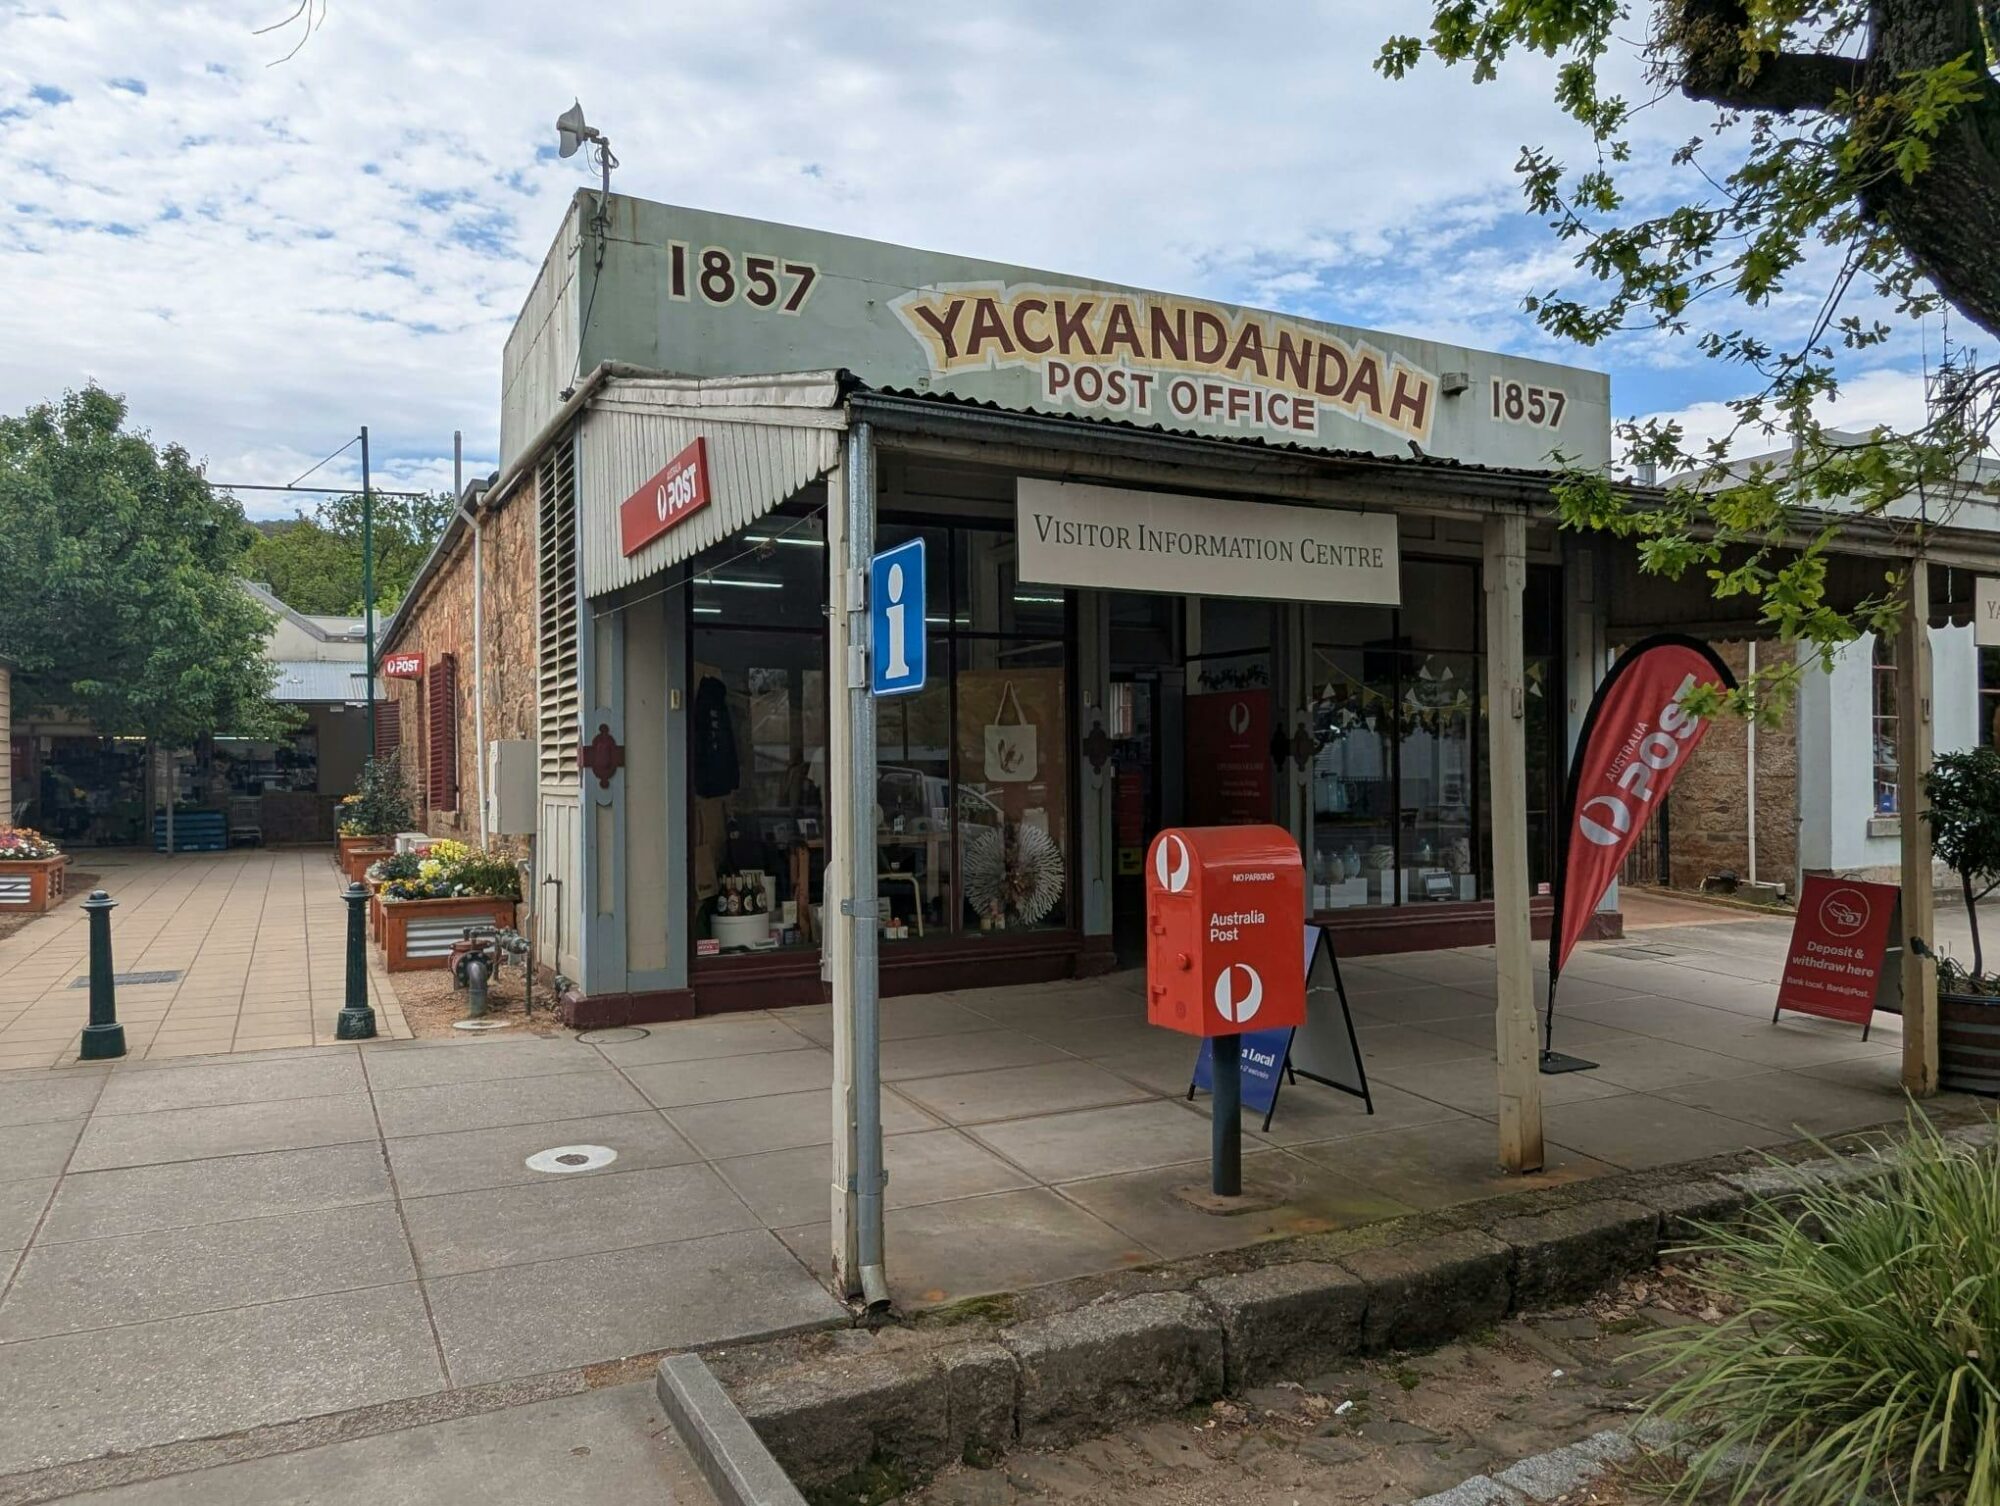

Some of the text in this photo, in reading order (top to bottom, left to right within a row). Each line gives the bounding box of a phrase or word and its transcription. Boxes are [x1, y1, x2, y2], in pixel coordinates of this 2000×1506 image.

[671, 244, 816, 312] 1857
[914, 298, 1429, 429] YACKANDANDAH
[1048, 360, 1319, 431] POST OFFICE
[1492, 380, 1566, 428] 1857
[667, 462, 697, 516] POST
[1033, 513, 1384, 569] VISITOR INFORMATION CENTRE
[395, 659, 420, 673] POST
[1605, 721, 1649, 783] AUSTRALIA
[1232, 873, 1244, 882] NO
[1210, 909, 1265, 927] Australia
[1210, 927, 1239, 943] Post
[1792, 955, 1874, 978] withdraw here
[1806, 940, 1864, 960] Deposit &
[1249, 1048, 1275, 1067] Local
